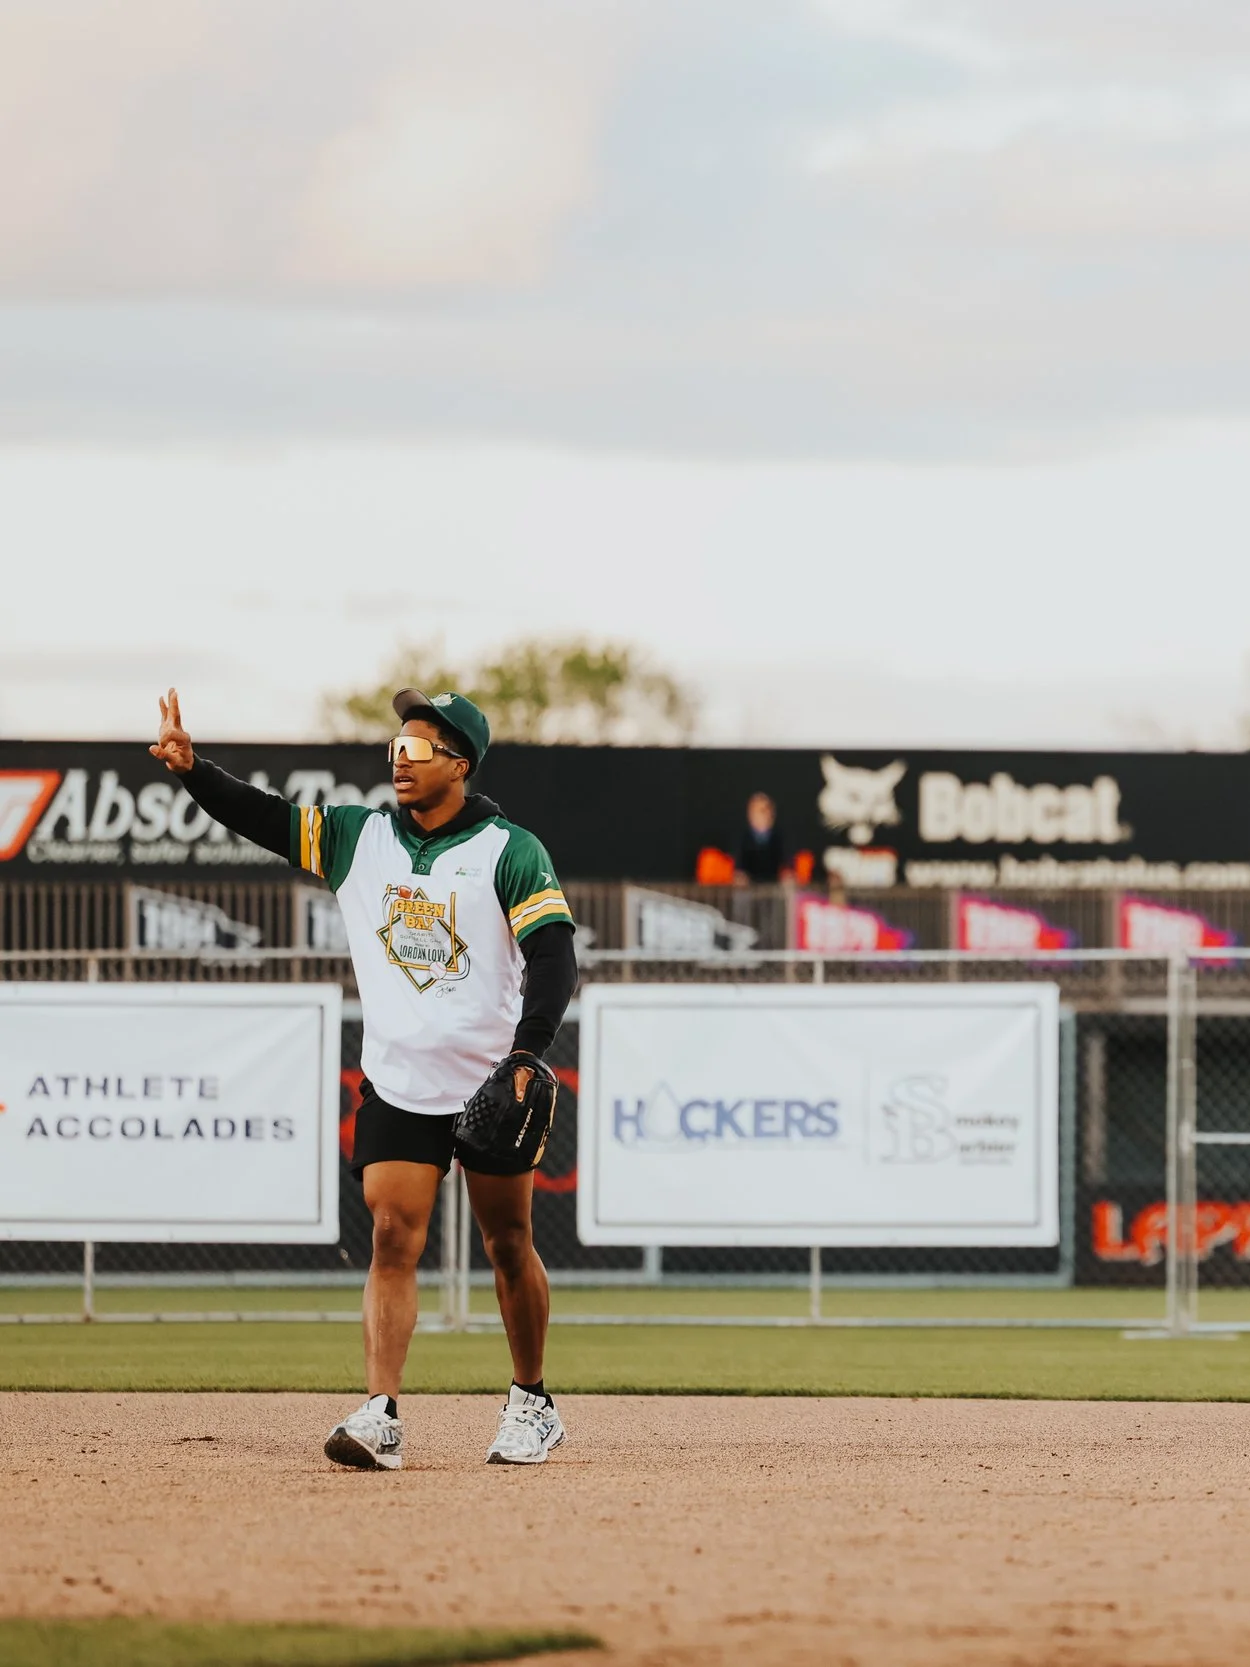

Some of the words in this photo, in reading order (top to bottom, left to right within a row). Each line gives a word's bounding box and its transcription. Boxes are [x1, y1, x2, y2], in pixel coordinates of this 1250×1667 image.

[34, 768, 400, 842] AbsoT
[918, 772, 1120, 843] Bobcat
[394, 899, 446, 918] GREEN
[404, 914, 435, 931] BAY
[400, 944, 427, 961] JORDAN
[428, 949, 447, 962] LOVE
[27, 1076, 219, 1099] ATHLETE
[27, 1116, 296, 1141] ACCOLADES
[515, 1107, 534, 1148] EASTON
